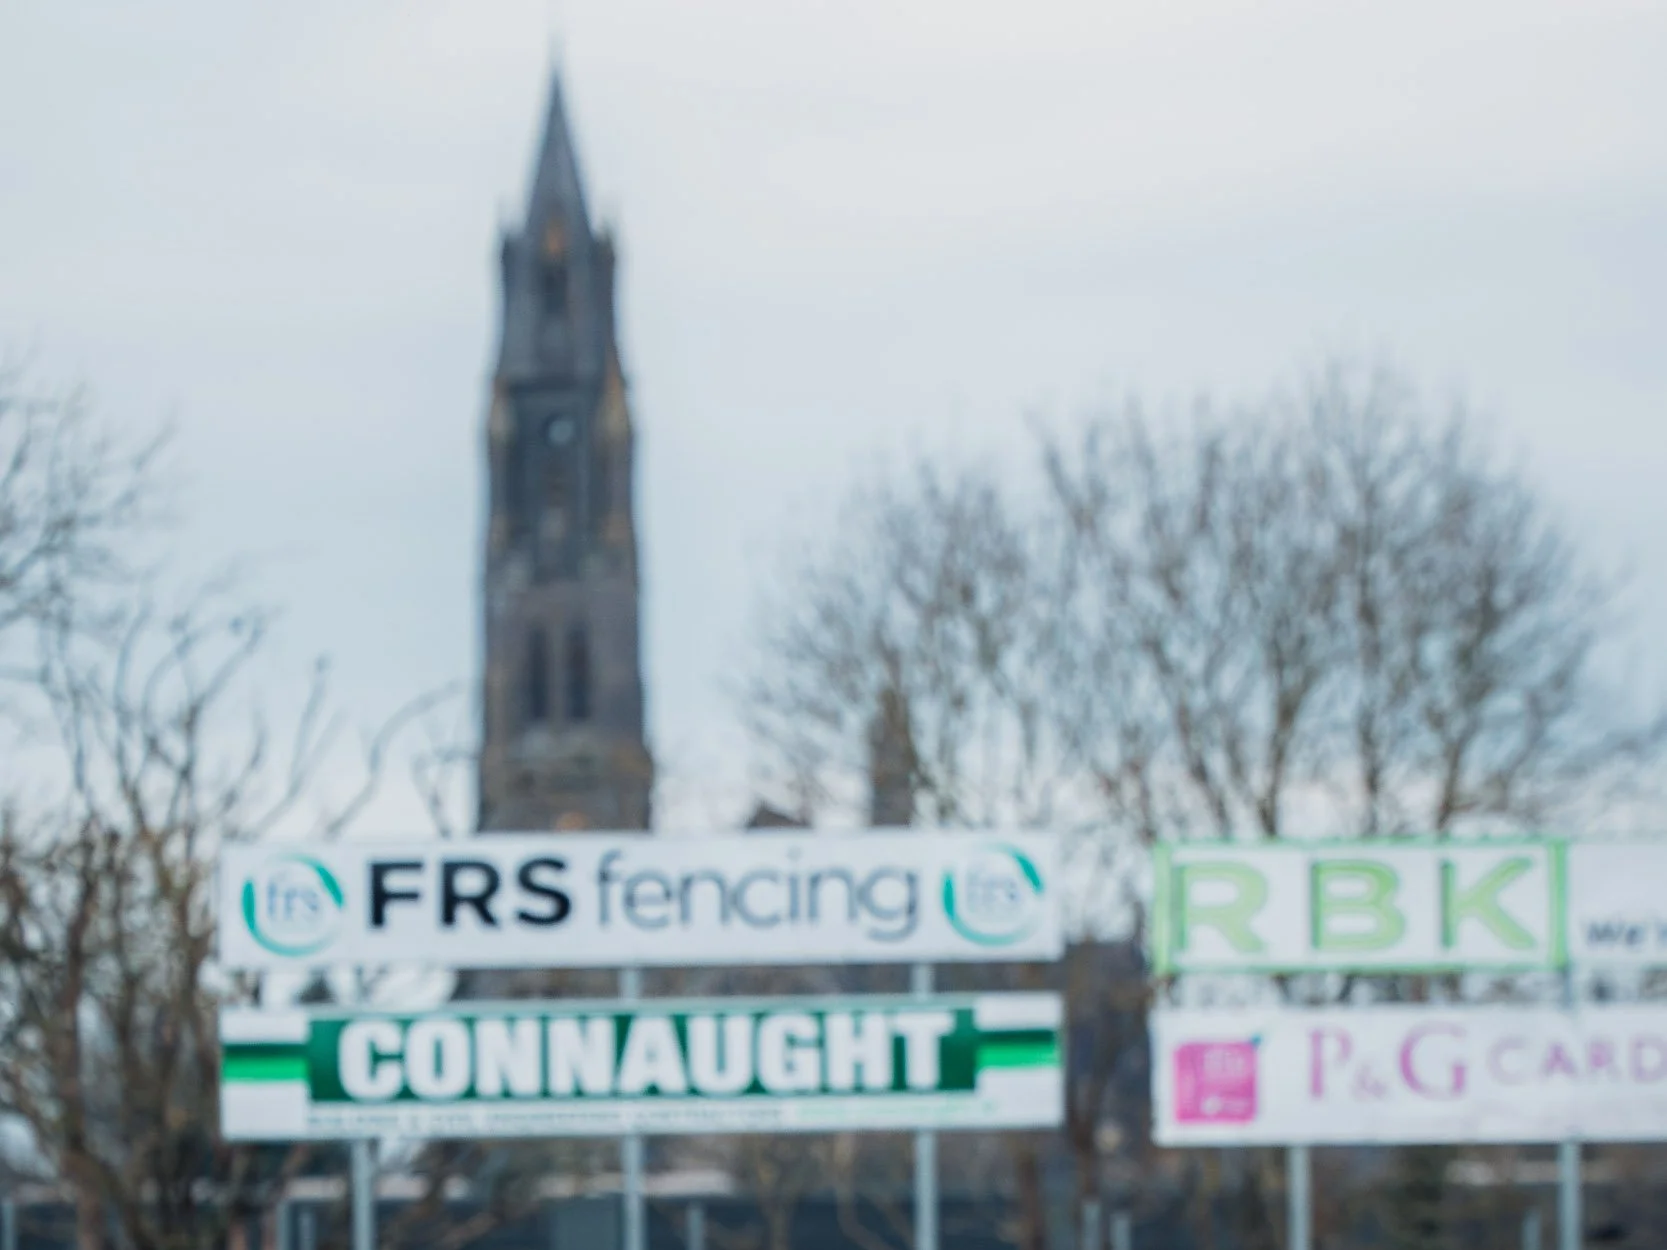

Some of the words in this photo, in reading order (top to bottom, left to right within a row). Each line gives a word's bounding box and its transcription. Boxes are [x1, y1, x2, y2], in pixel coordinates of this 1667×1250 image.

[369, 857, 572, 929] FRS
[598, 850, 920, 942] fencing
[1171, 857, 1538, 952] RBK
[337, 1010, 953, 1101] CONNAUGHT
[1306, 1021, 1468, 1101] P&G
